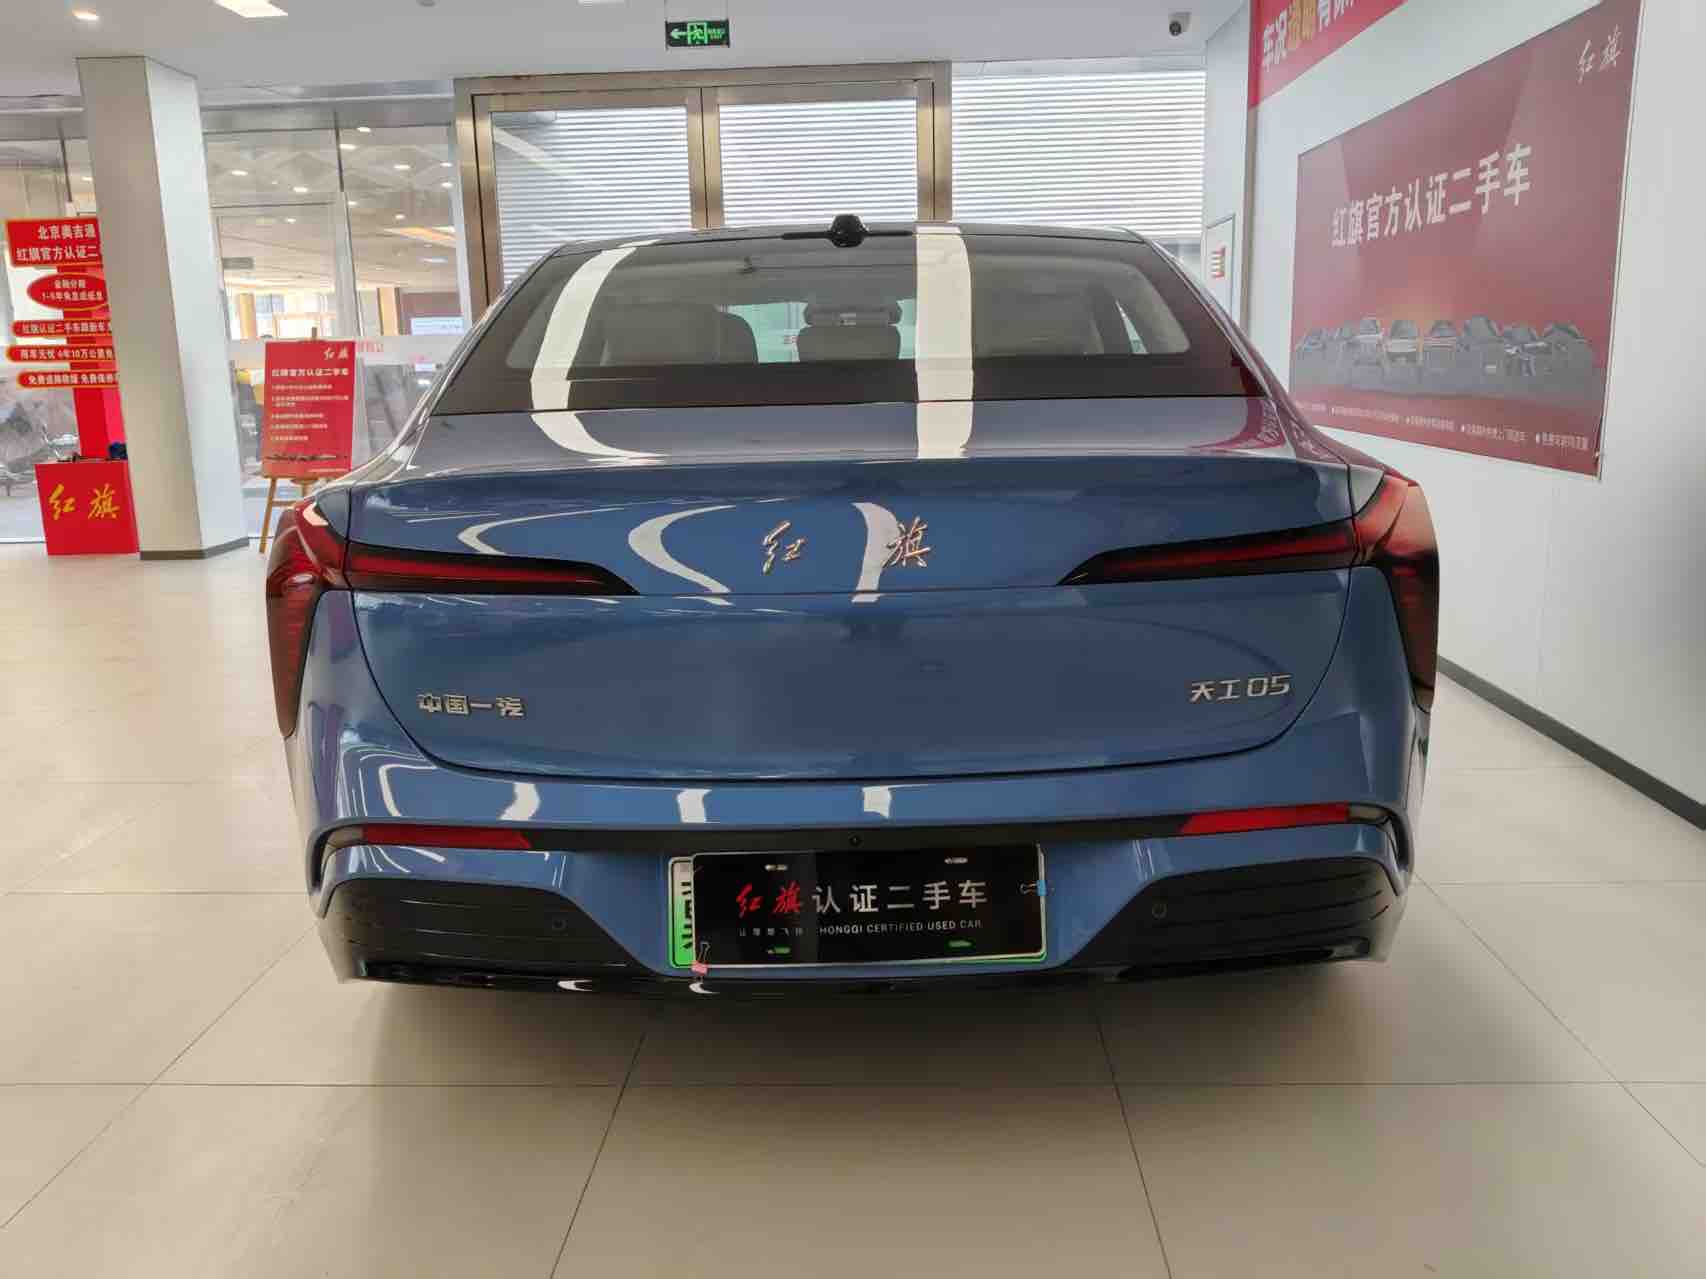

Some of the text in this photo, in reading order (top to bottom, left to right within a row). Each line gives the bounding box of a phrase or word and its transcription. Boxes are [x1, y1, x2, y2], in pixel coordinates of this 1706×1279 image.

[1577, 24, 1622, 84] 红旗
[1331, 143, 1532, 248] 红旗官方认证二手车
[16, 245, 98, 262] 红旗官方认证二
[48, 484, 120, 520] 红旗
[762, 515, 931, 576] 红旗
[417, 693, 525, 717] 中国一汽
[819, 919, 982, 936] HONGQI CERTIFIED USED CAR
